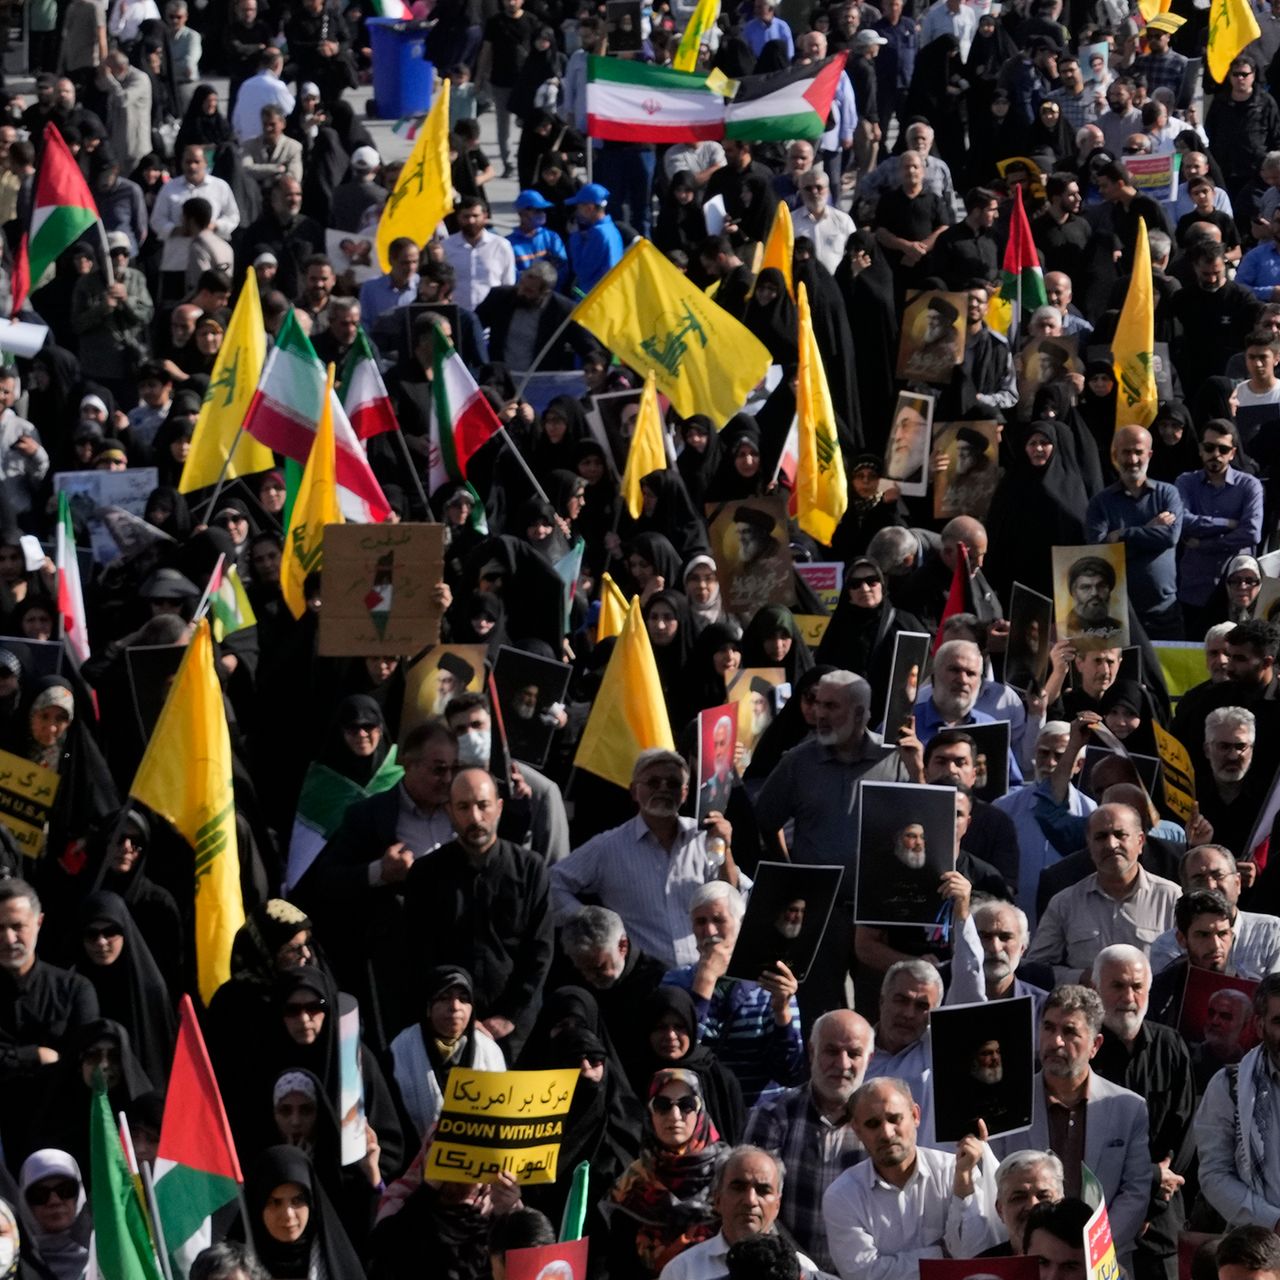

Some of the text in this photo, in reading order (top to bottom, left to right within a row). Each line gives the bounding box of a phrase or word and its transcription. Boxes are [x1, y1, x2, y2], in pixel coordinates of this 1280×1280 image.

[517, 1093, 535, 1112] بر
[540, 1080, 569, 1109] مرگ
[438, 1119, 496, 1140] DOWN
[500, 1124, 536, 1141] WITH
